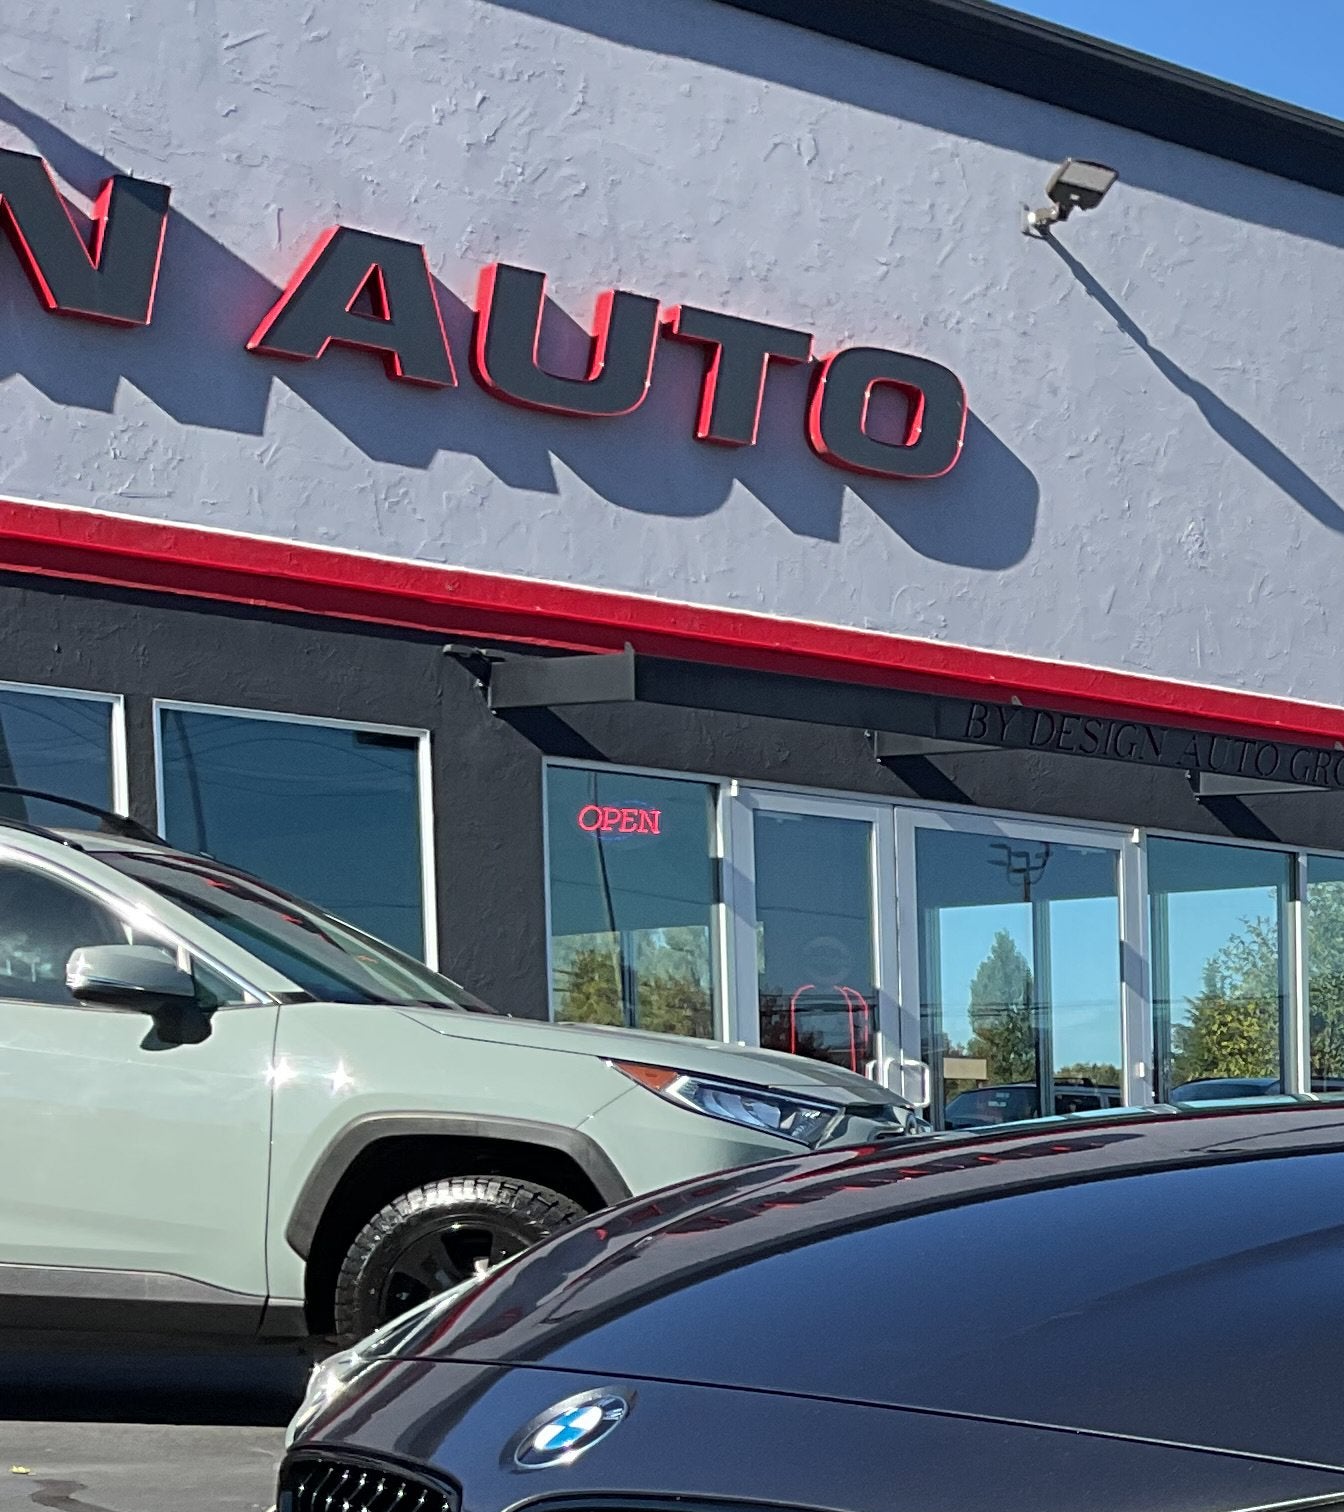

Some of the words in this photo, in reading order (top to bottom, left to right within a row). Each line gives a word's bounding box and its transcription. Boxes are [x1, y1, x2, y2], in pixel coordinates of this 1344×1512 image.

[245, 225, 968, 480] AUTO
[964, 702, 1021, 741] BY
[1029, 711, 1168, 762] DESIGN
[1176, 734, 1280, 777] AUTO
[578, 804, 662, 835] OPEN
